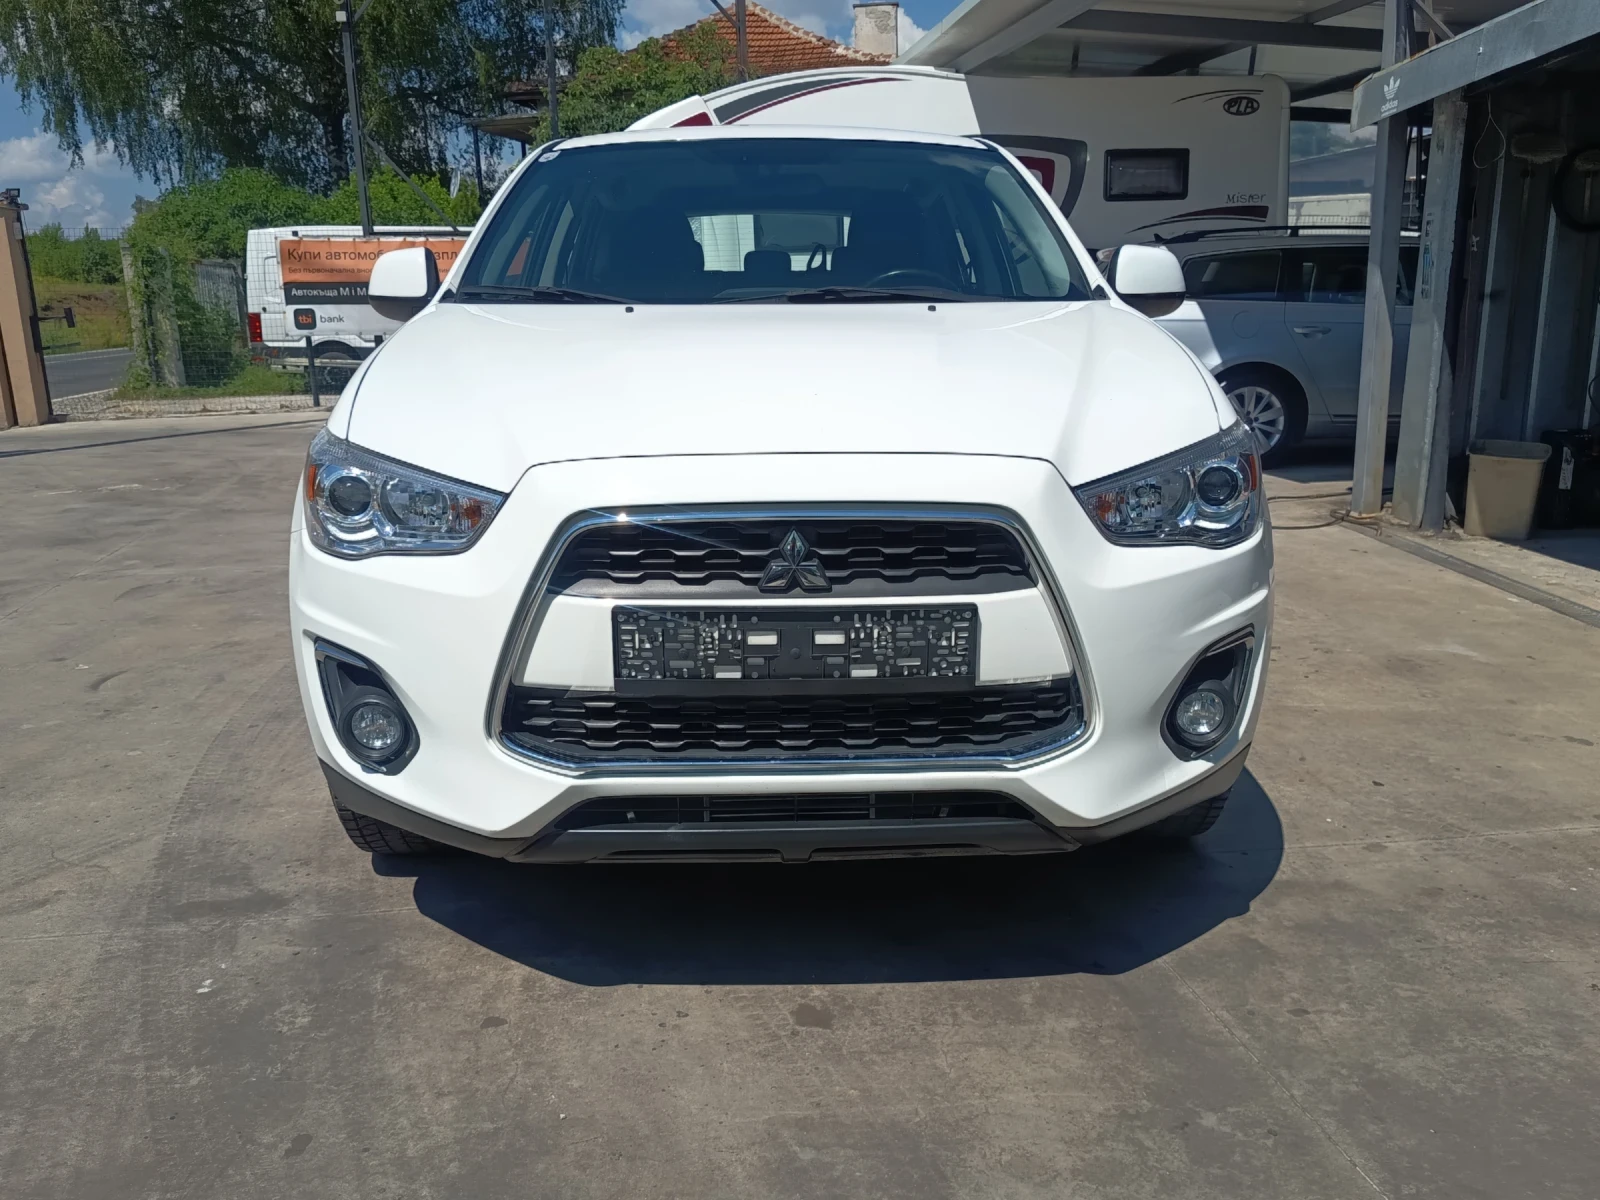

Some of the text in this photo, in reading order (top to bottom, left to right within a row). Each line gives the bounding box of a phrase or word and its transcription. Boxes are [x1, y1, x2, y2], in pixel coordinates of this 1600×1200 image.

[1381, 100, 1398, 113] adidas
[1225, 192, 1266, 204] Mister
[287, 248, 321, 262] Купи
[291, 287, 338, 298] Автокъща
[298, 314, 345, 324] tbi bank
